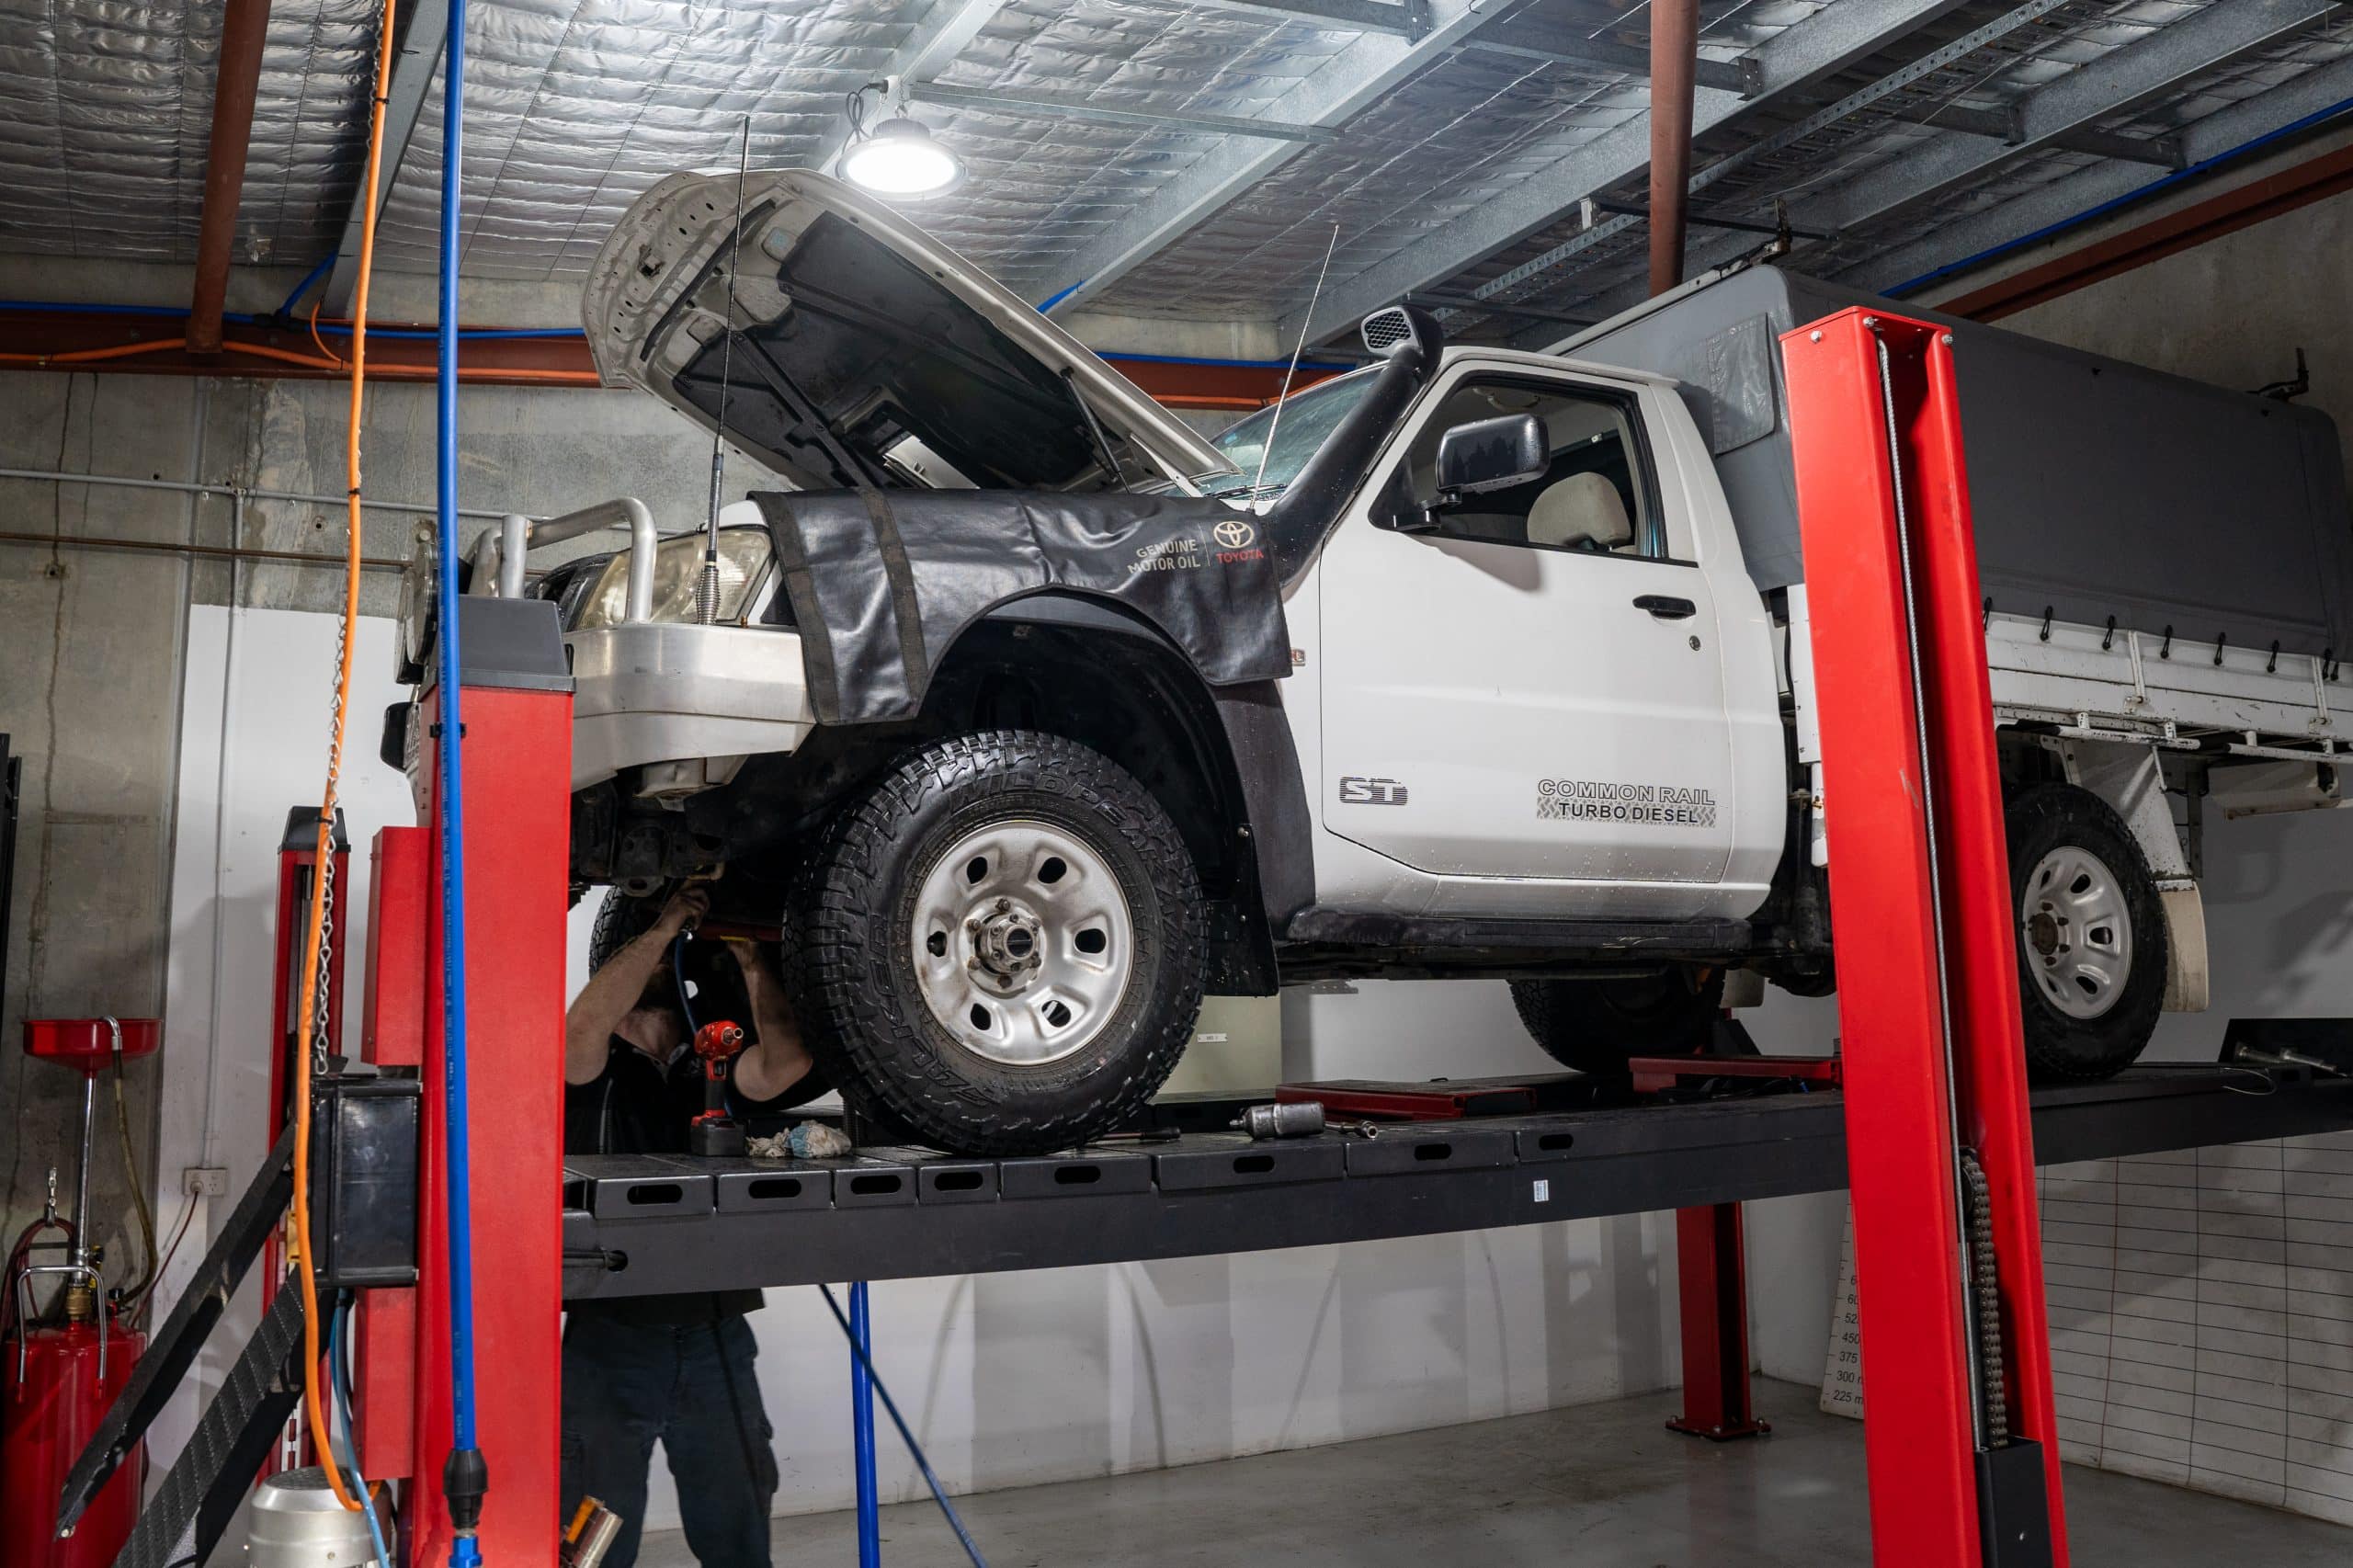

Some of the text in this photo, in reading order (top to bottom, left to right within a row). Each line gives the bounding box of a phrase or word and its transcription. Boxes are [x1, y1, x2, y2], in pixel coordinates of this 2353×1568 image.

[1136, 539, 1198, 558] GENUINE
[1216, 549, 1264, 563] TOYOTA
[1127, 555, 1200, 574] MOTOR OIL
[1341, 778, 1407, 804] ST
[1538, 778, 1715, 805] COMMON RAIL
[1559, 802, 1699, 823] TURBO DIESEL
[1839, 1351, 1858, 1363] 375
[1836, 1370, 1855, 1382] 300
[1833, 1390, 1852, 1403] 225
